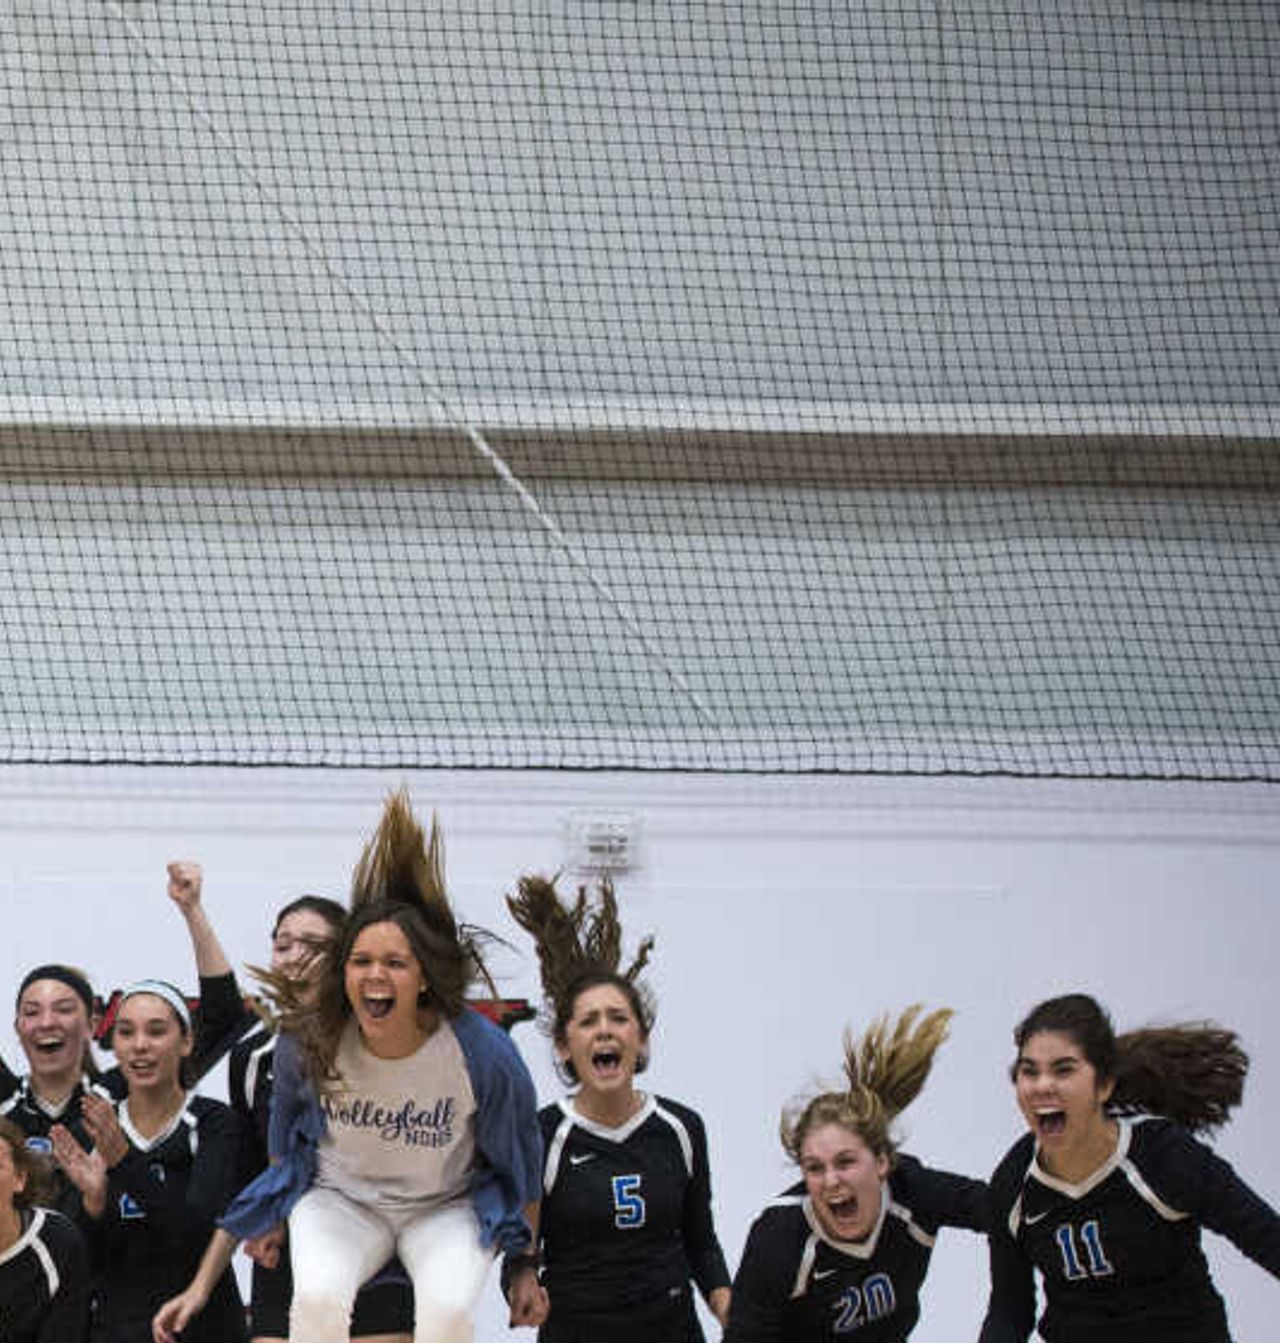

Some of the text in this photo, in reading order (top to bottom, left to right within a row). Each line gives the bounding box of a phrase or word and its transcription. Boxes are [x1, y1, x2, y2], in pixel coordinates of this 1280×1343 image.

[611, 1174, 646, 1230] 5
[1056, 1220, 1114, 1281] 11
[833, 1271, 897, 1333] 20
